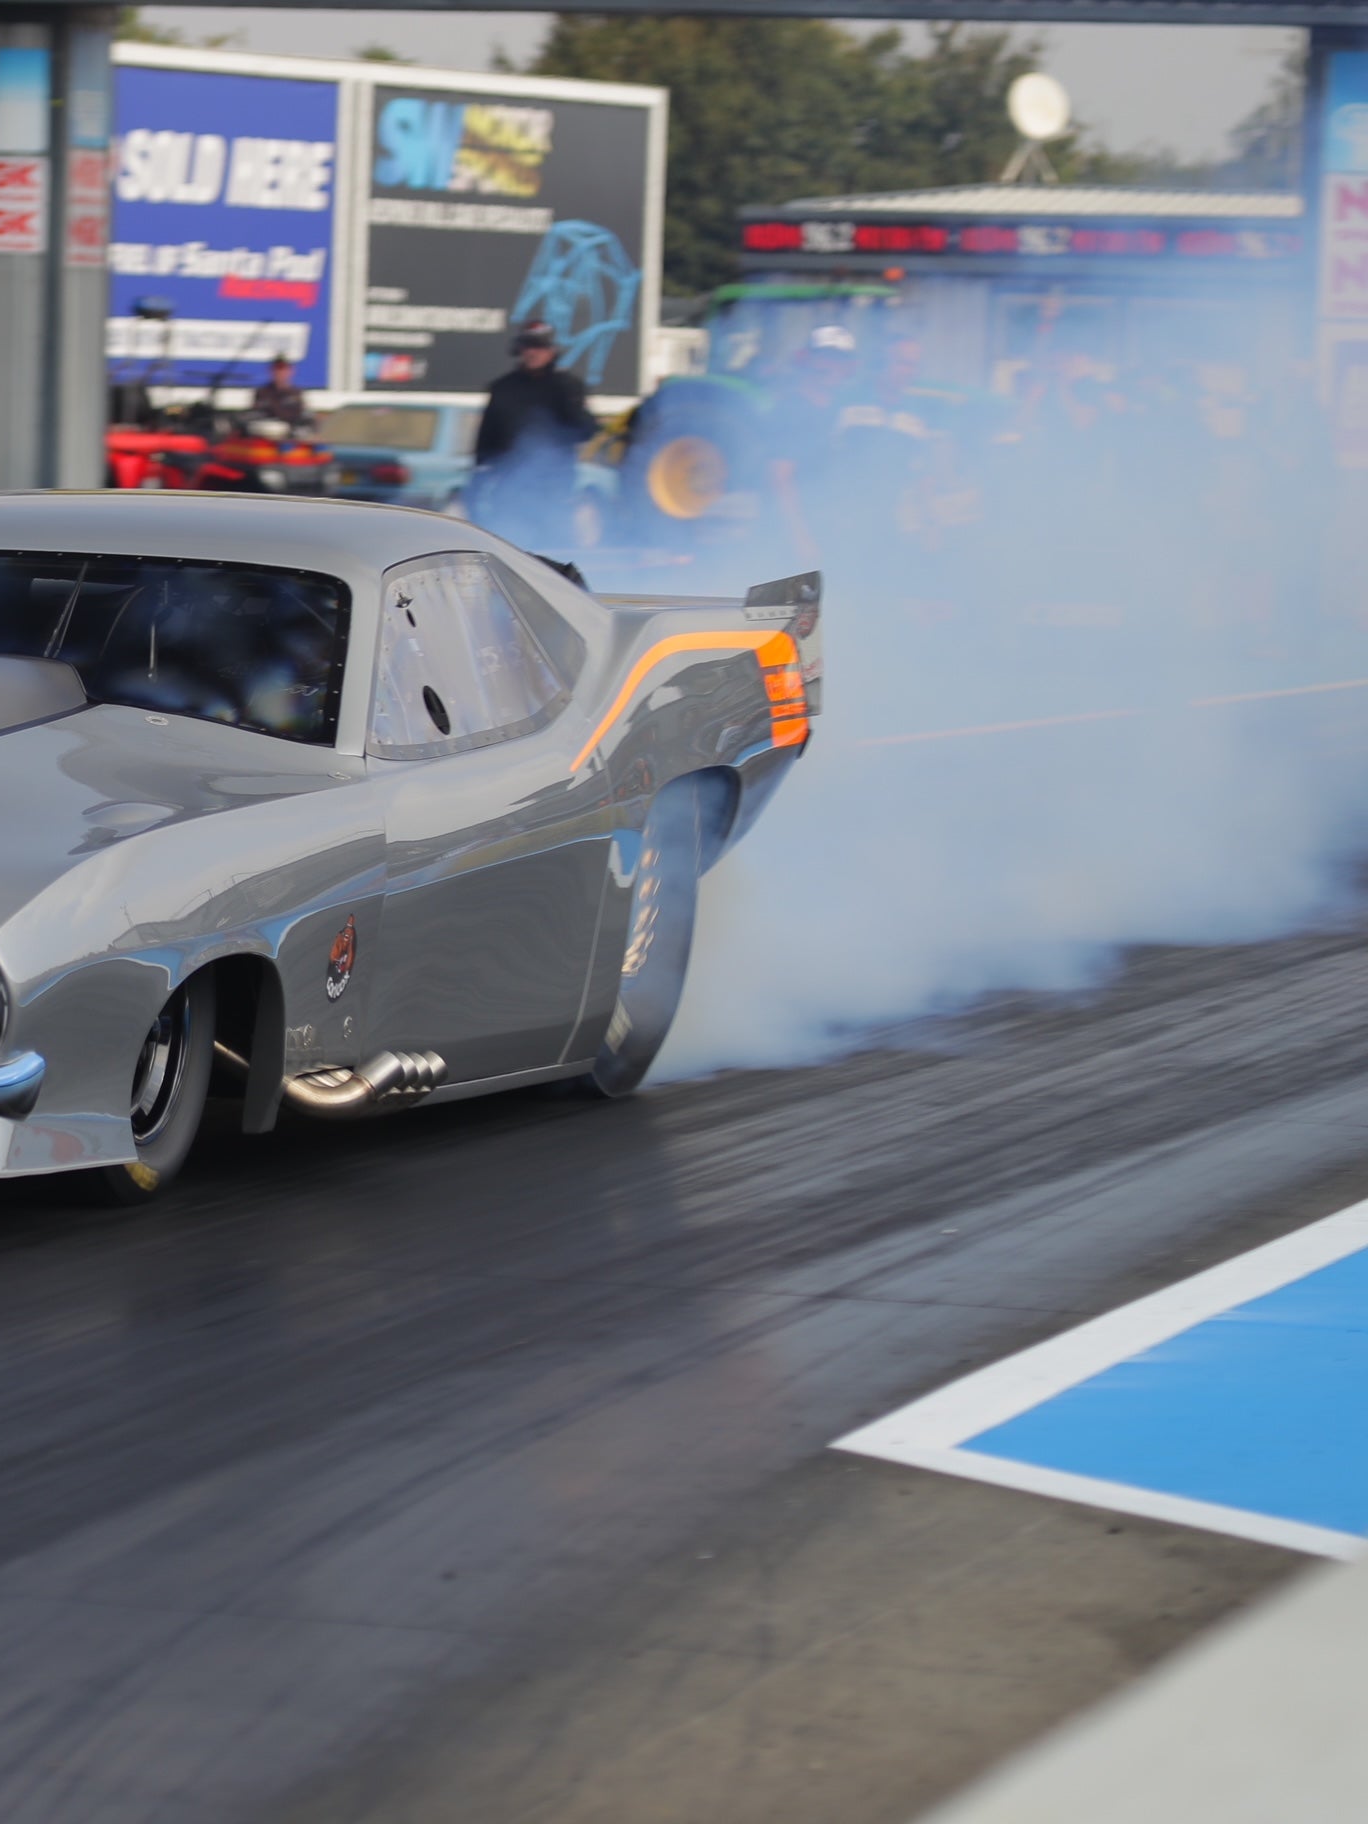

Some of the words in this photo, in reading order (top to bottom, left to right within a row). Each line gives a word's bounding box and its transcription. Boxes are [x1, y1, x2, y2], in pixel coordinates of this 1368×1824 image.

[116, 128, 227, 206] SOLD
[225, 136, 334, 212] HERE
[177, 241, 267, 281] Santa
[266, 246, 327, 284] Pod
